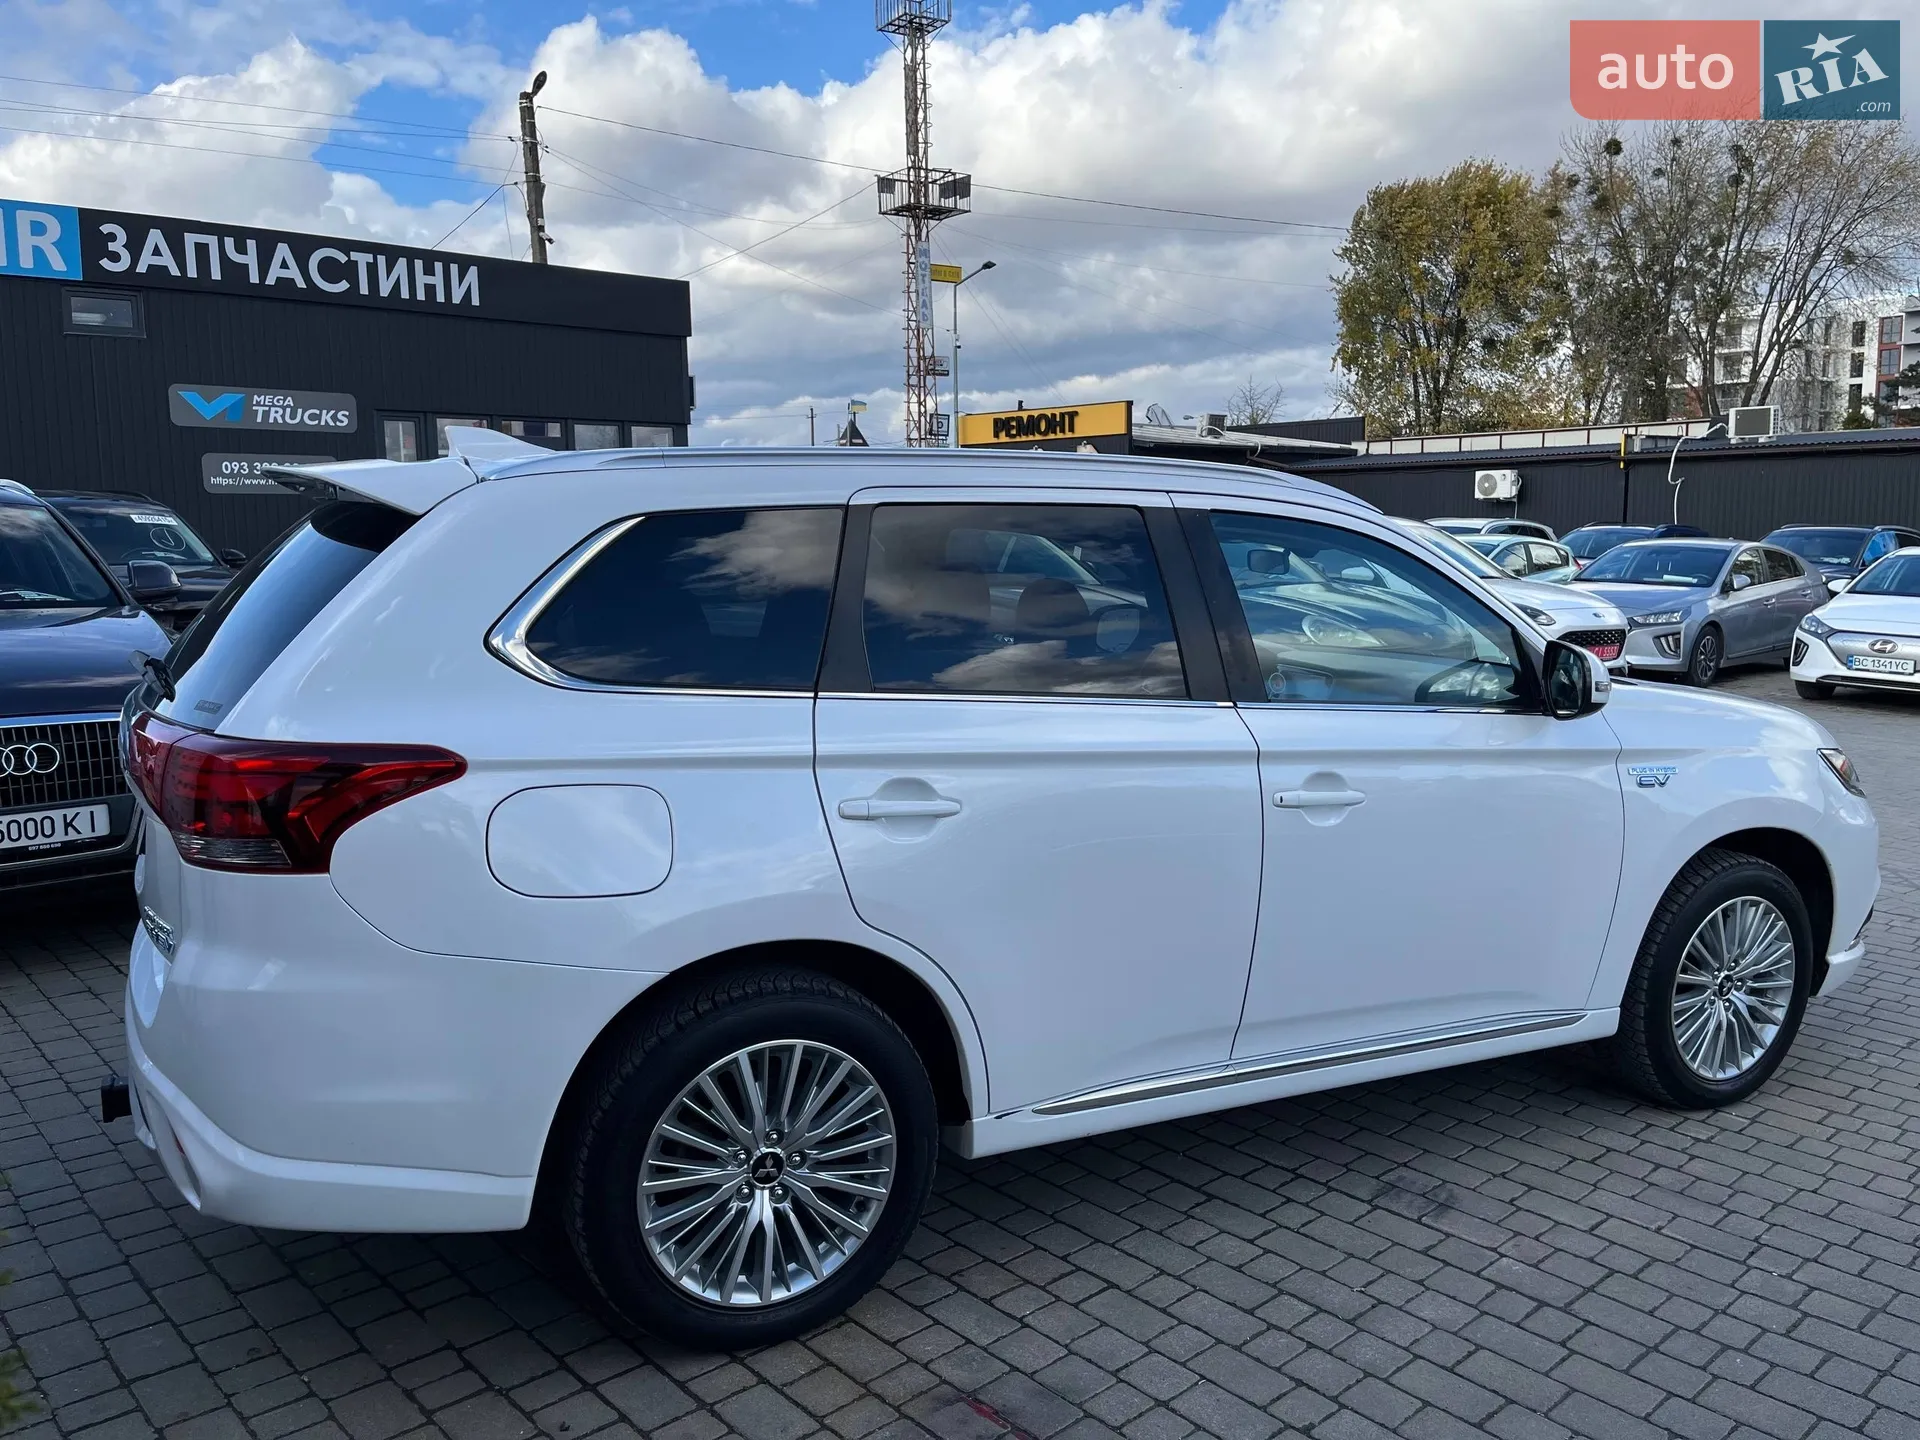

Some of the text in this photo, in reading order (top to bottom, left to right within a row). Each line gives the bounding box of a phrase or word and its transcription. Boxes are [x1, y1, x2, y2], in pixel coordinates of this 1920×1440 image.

[99, 223, 480, 307] ЗАПЧАСТИНИ
[253, 395, 294, 407] MEGA
[252, 407, 349, 427] TRUCKS
[993, 411, 1079, 440] РЕМОНТ
[222, 461, 249, 474] 093
[1853, 657, 1869, 668] BC
[1870, 659, 1893, 669] 1341
[1636, 773, 1671, 788] EV
